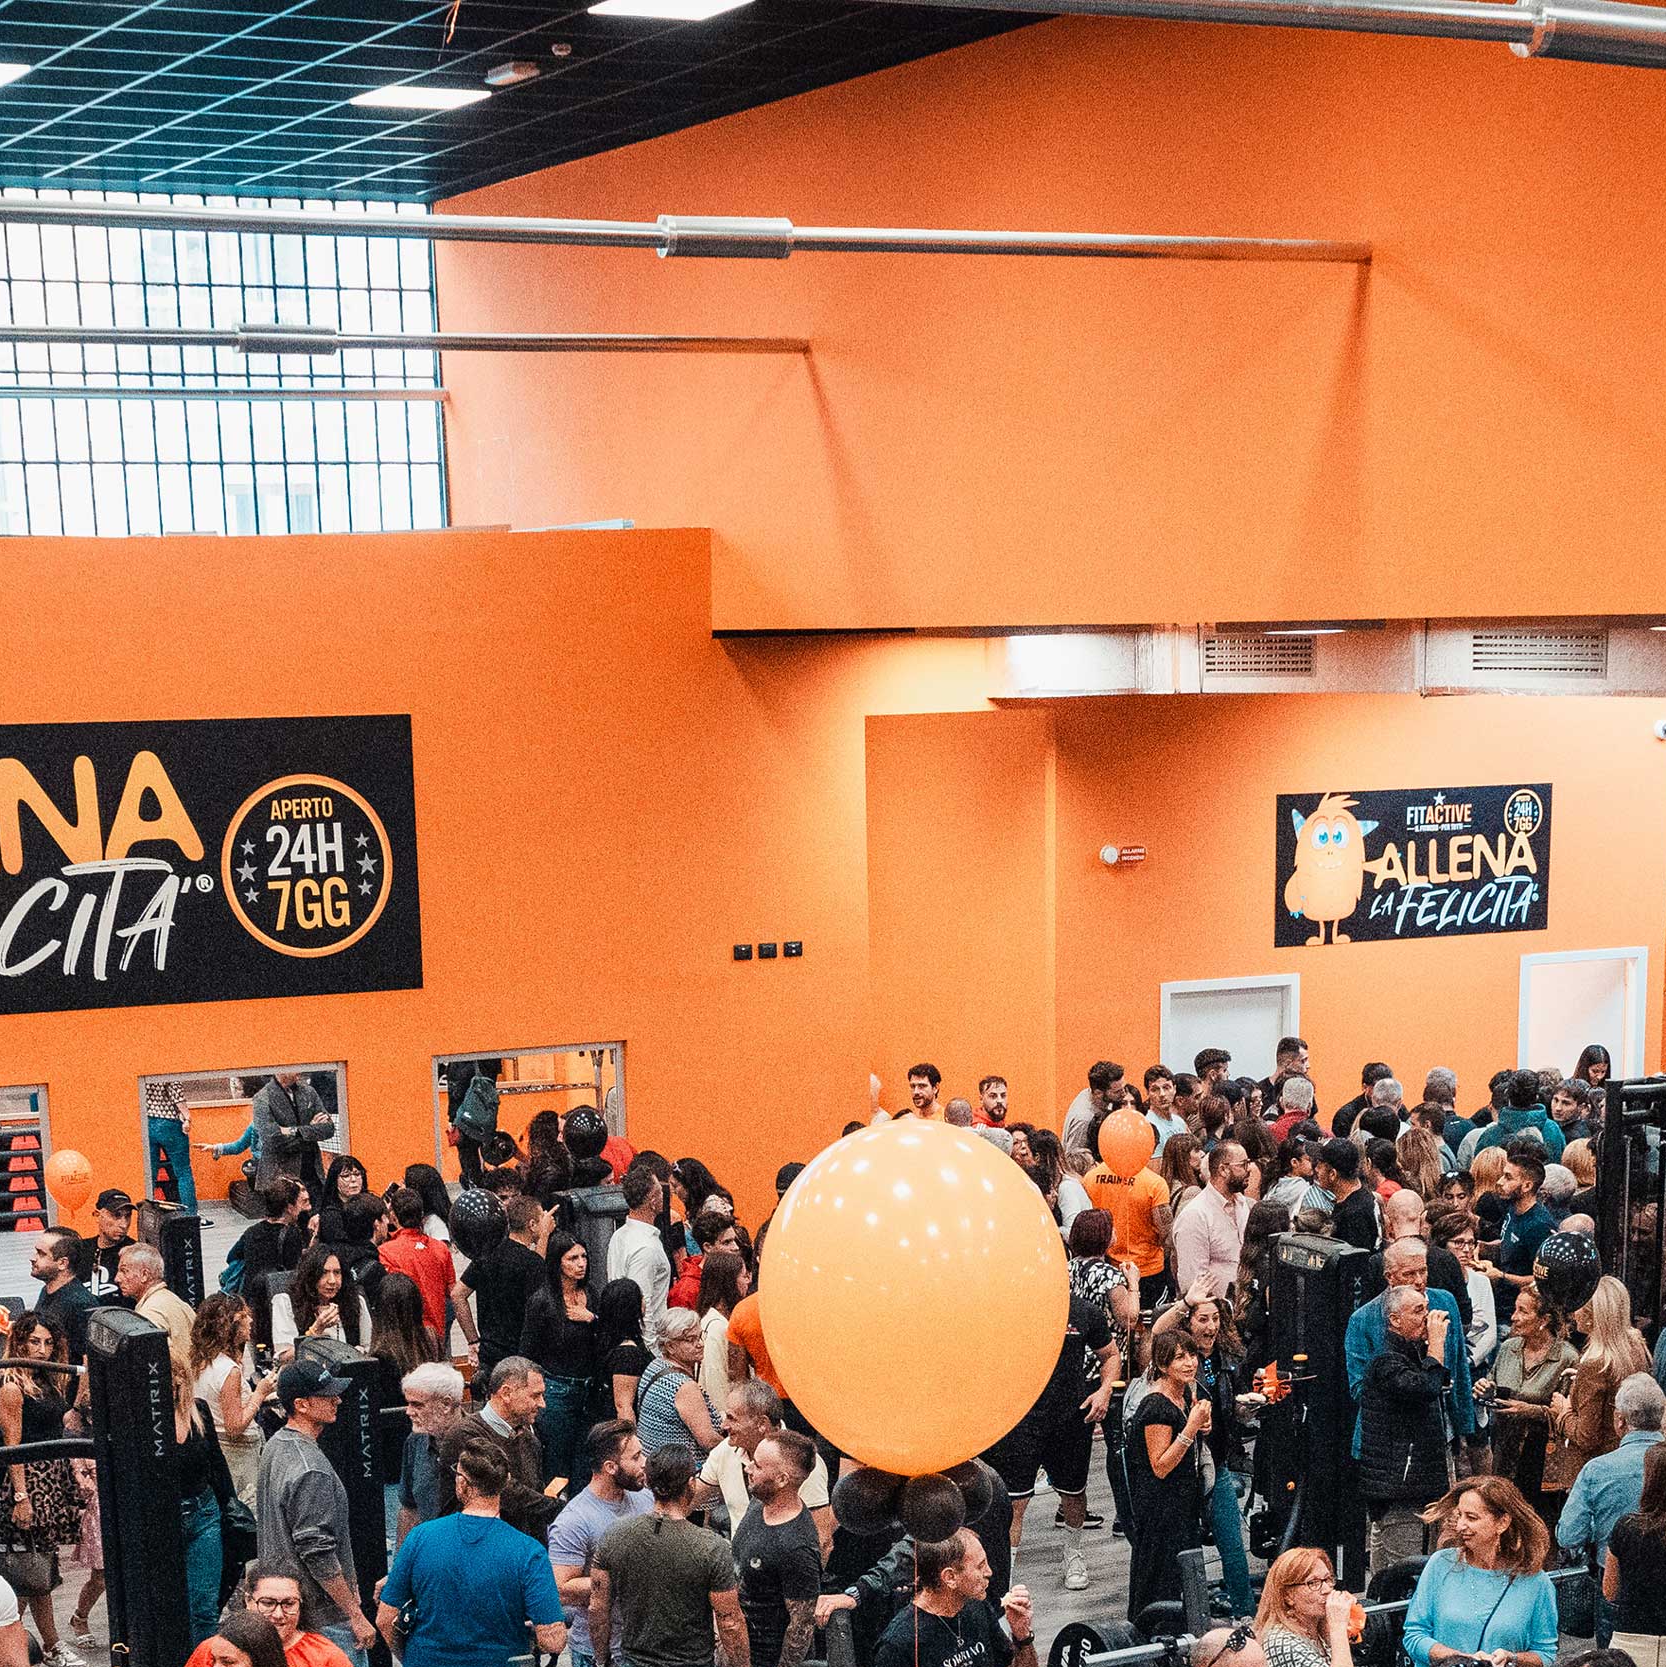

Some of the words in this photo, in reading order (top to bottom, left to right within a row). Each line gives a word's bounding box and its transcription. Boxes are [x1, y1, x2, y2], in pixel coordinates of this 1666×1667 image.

[270, 798, 333, 820] APERTO
[1407, 803, 1472, 826] FITACTIVE
[1514, 803, 1532, 817] 24H
[1515, 816, 1532, 831] 7GG
[265, 822, 342, 876] 24H
[1373, 832, 1538, 890] ALLENA
[273, 876, 350, 932] 7GG
[1369, 894, 1392, 920] LA
[148, 1362, 164, 1456] MATRIX
[359, 1386, 372, 1478] MATRIX
